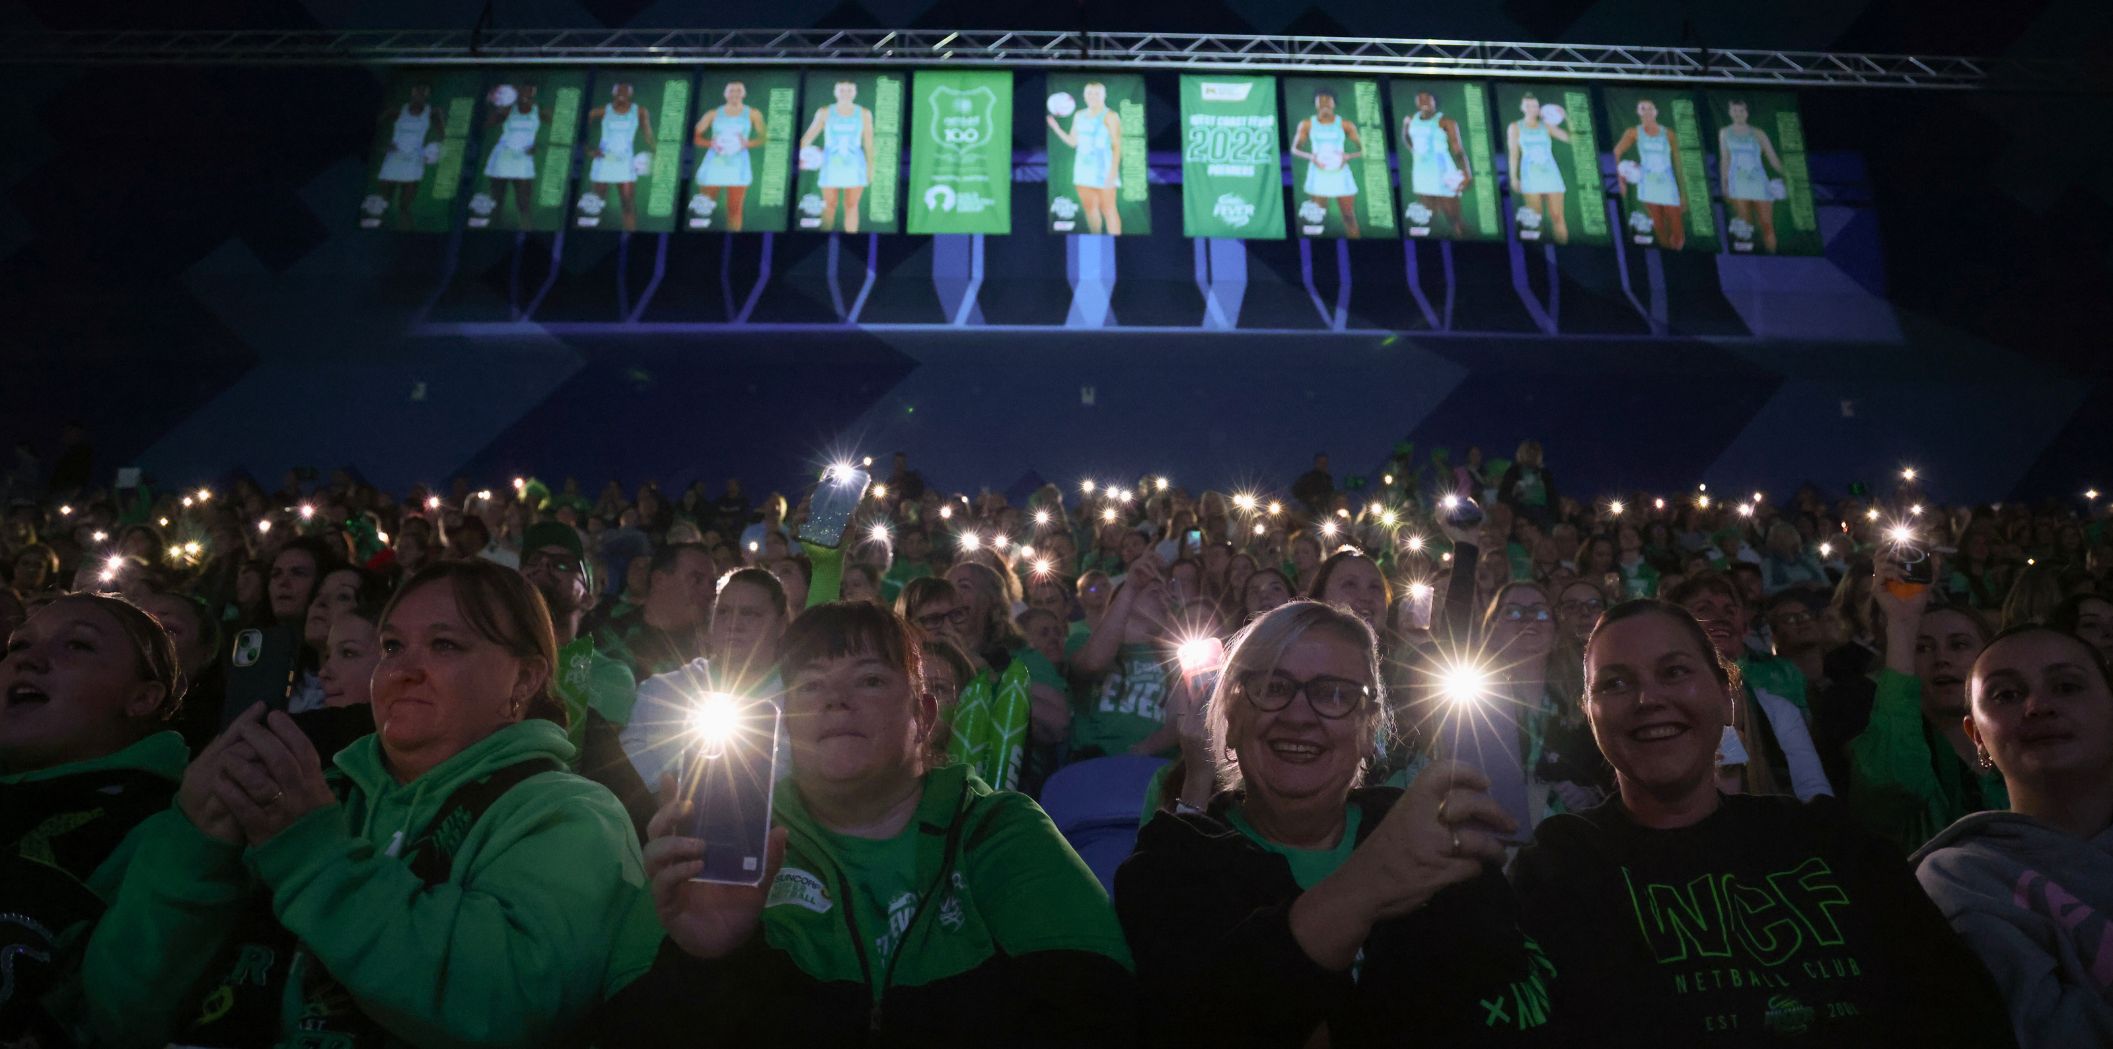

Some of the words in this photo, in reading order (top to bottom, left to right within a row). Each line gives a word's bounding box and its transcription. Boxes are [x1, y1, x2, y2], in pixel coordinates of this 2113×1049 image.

[944, 128, 979, 143] 100
[1187, 127, 1273, 163] 2022
[1619, 857, 1849, 967] WCF
[1673, 967, 1792, 993] NETBALL
[1801, 957, 1860, 980] CLUB
[1704, 1014, 1738, 1031] EST
